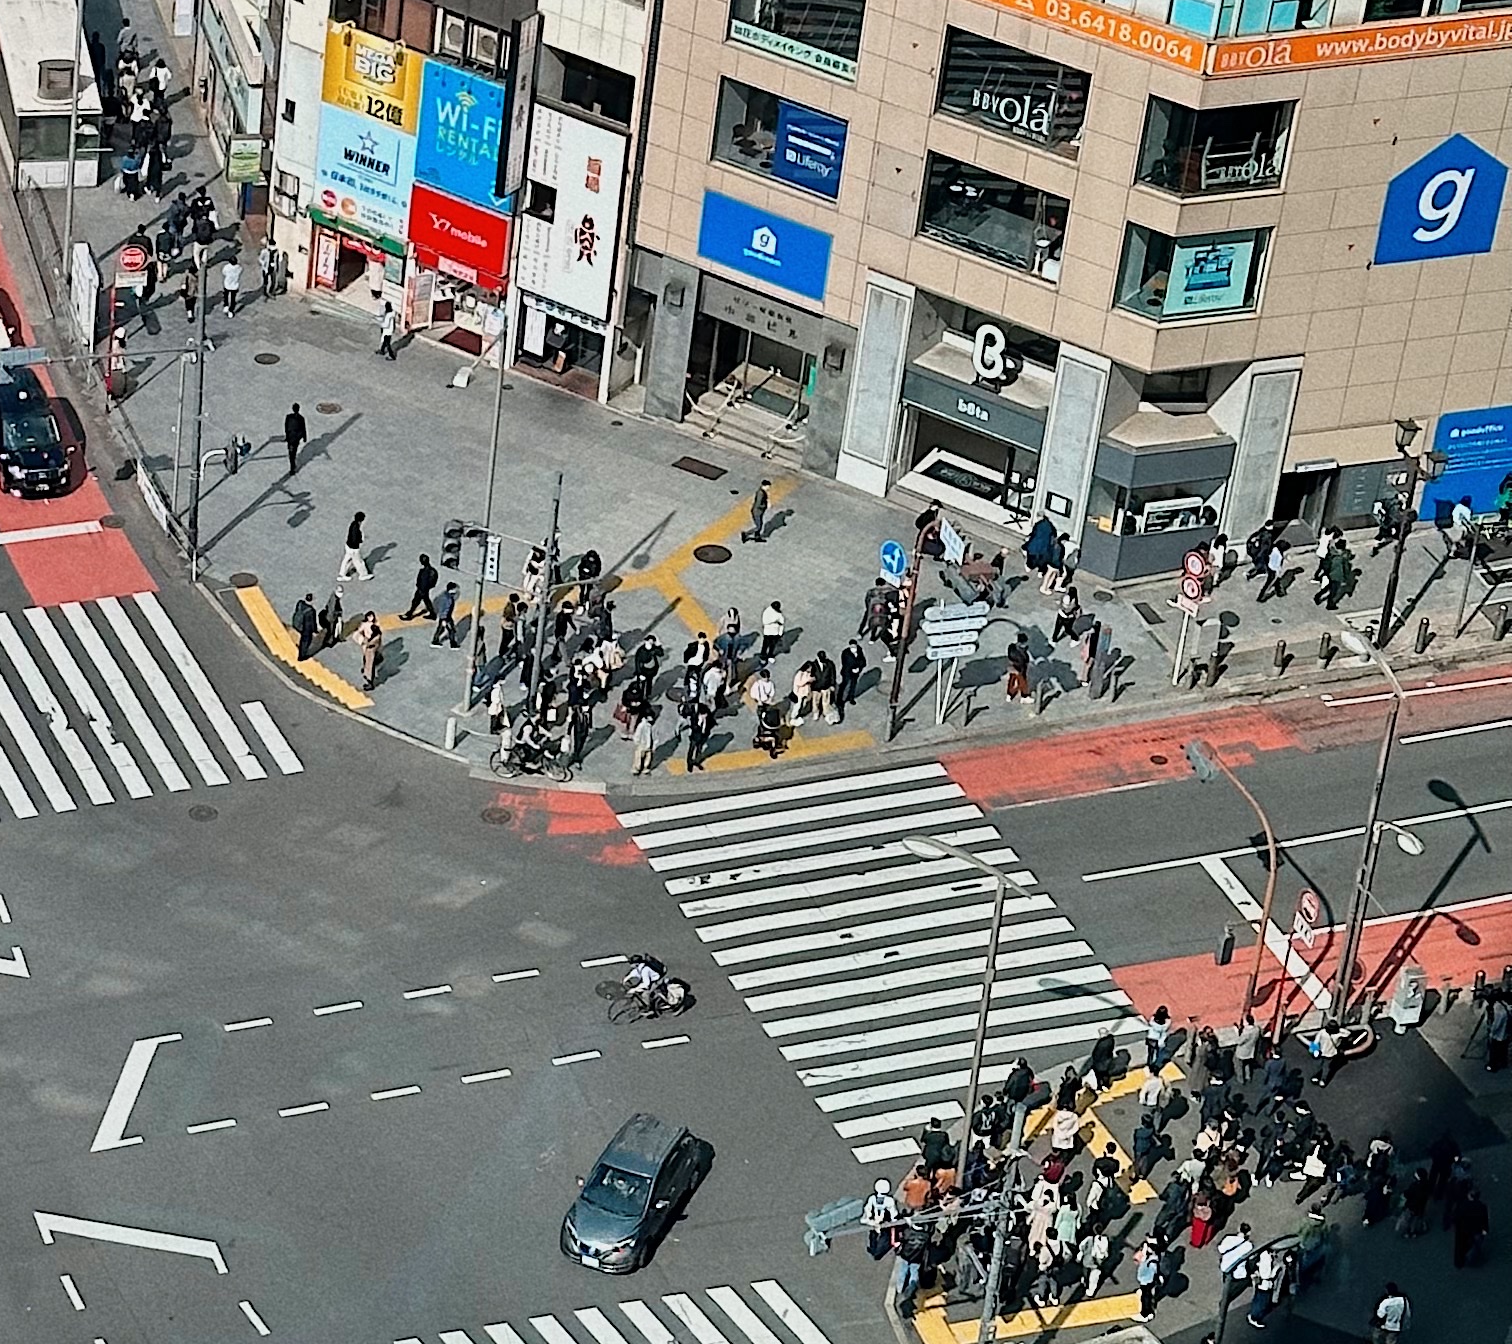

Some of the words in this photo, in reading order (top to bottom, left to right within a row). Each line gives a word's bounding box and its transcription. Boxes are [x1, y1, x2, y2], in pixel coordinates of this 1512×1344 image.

[1315, 22, 1512, 58] www.bodybyvital.jp
[354, 54, 396, 84] BIG
[365, 95, 403, 127] 12億
[343, 147, 391, 177] WINNER
[1412, 166, 1476, 244] g
